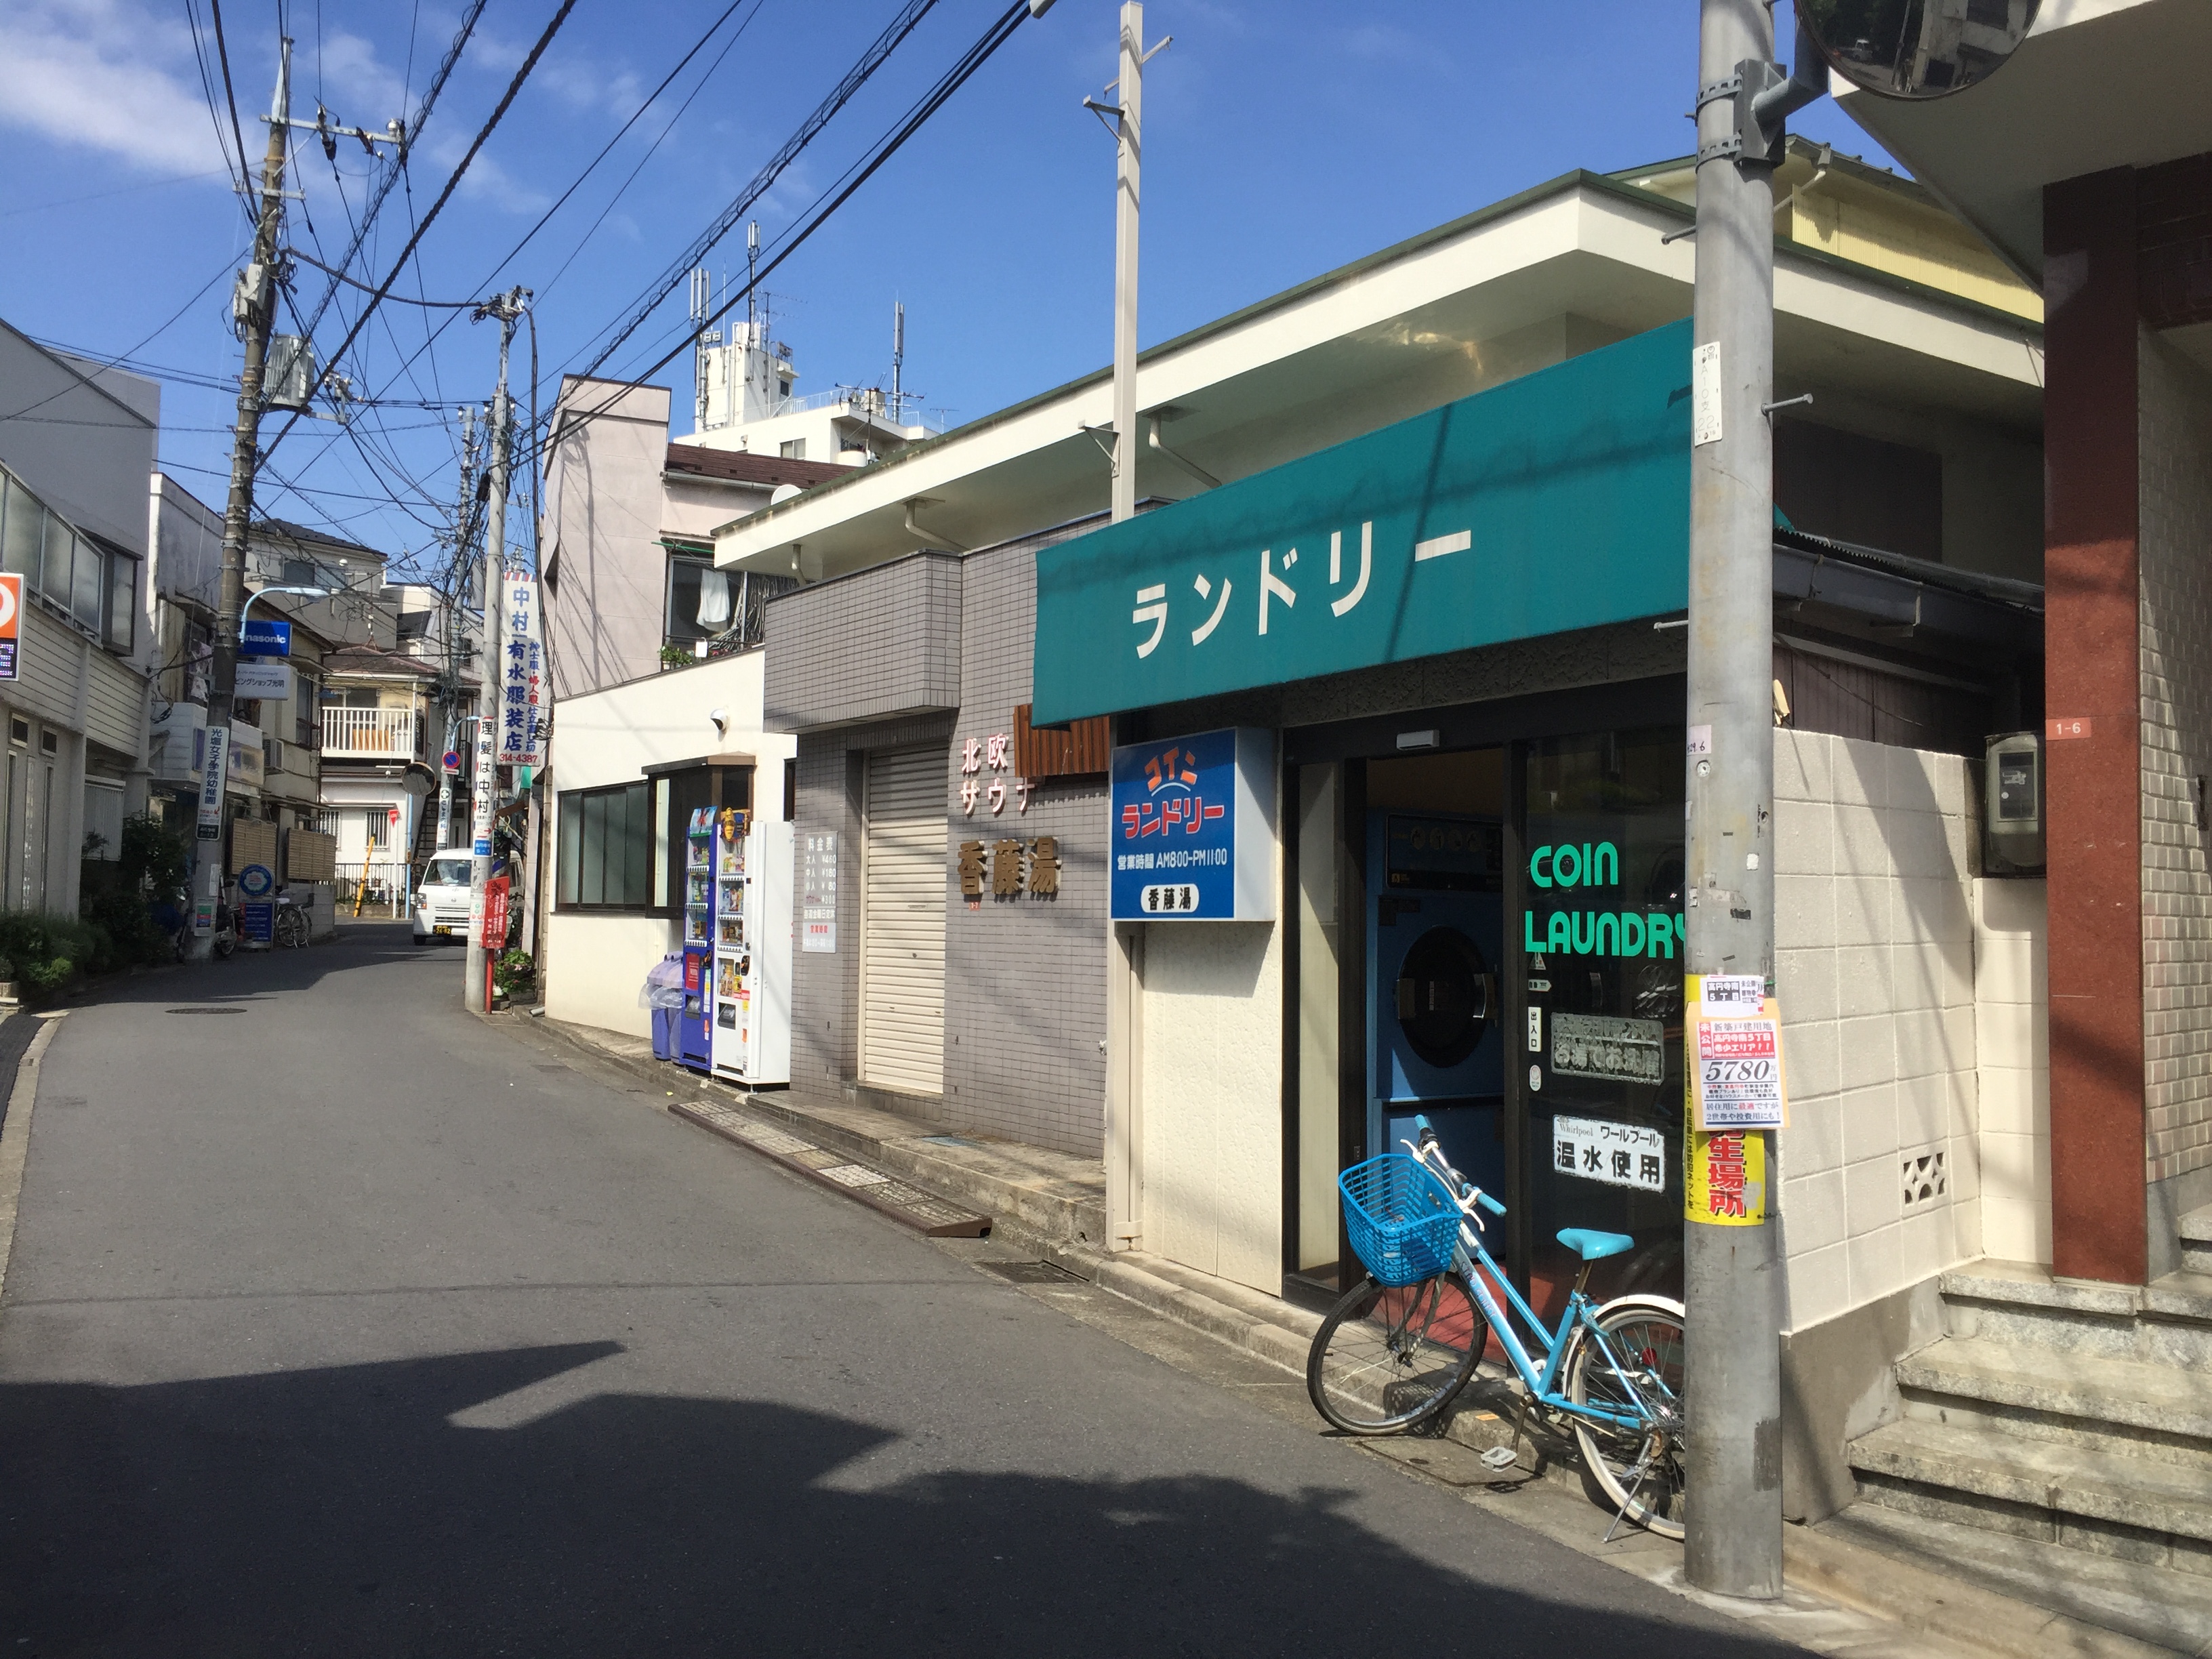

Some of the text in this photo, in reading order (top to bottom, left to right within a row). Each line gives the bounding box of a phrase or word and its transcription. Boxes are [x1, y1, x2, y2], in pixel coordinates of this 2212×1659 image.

[1132, 521, 1471, 659] ランドリー
[245, 634, 286, 644] nasonic
[504, 640, 527, 752] 有水服装店
[2056, 722, 2081, 735] 1-6
[478, 721, 493, 813] 理髪は中村
[499, 753, 539, 764] 314-4387
[962, 733, 1010, 773] 北欧
[1145, 747, 1197, 792] コイン
[960, 777, 1036, 815] サウナ
[1122, 797, 1225, 840] ランドリー
[1118, 853, 1154, 870] 営業時間
[1530, 841, 1618, 888] COIN
[1148, 886, 1191, 910] 香藤湯
[1714, 1022, 1773, 1032] 新築戸建用地
[1705, 1060, 1770, 1081] 5780
[1559, 1123, 1593, 1137] Whirlpool
[1600, 1126, 1660, 1148] ワールプール
[1557, 1139, 1660, 1185] 温水使用
